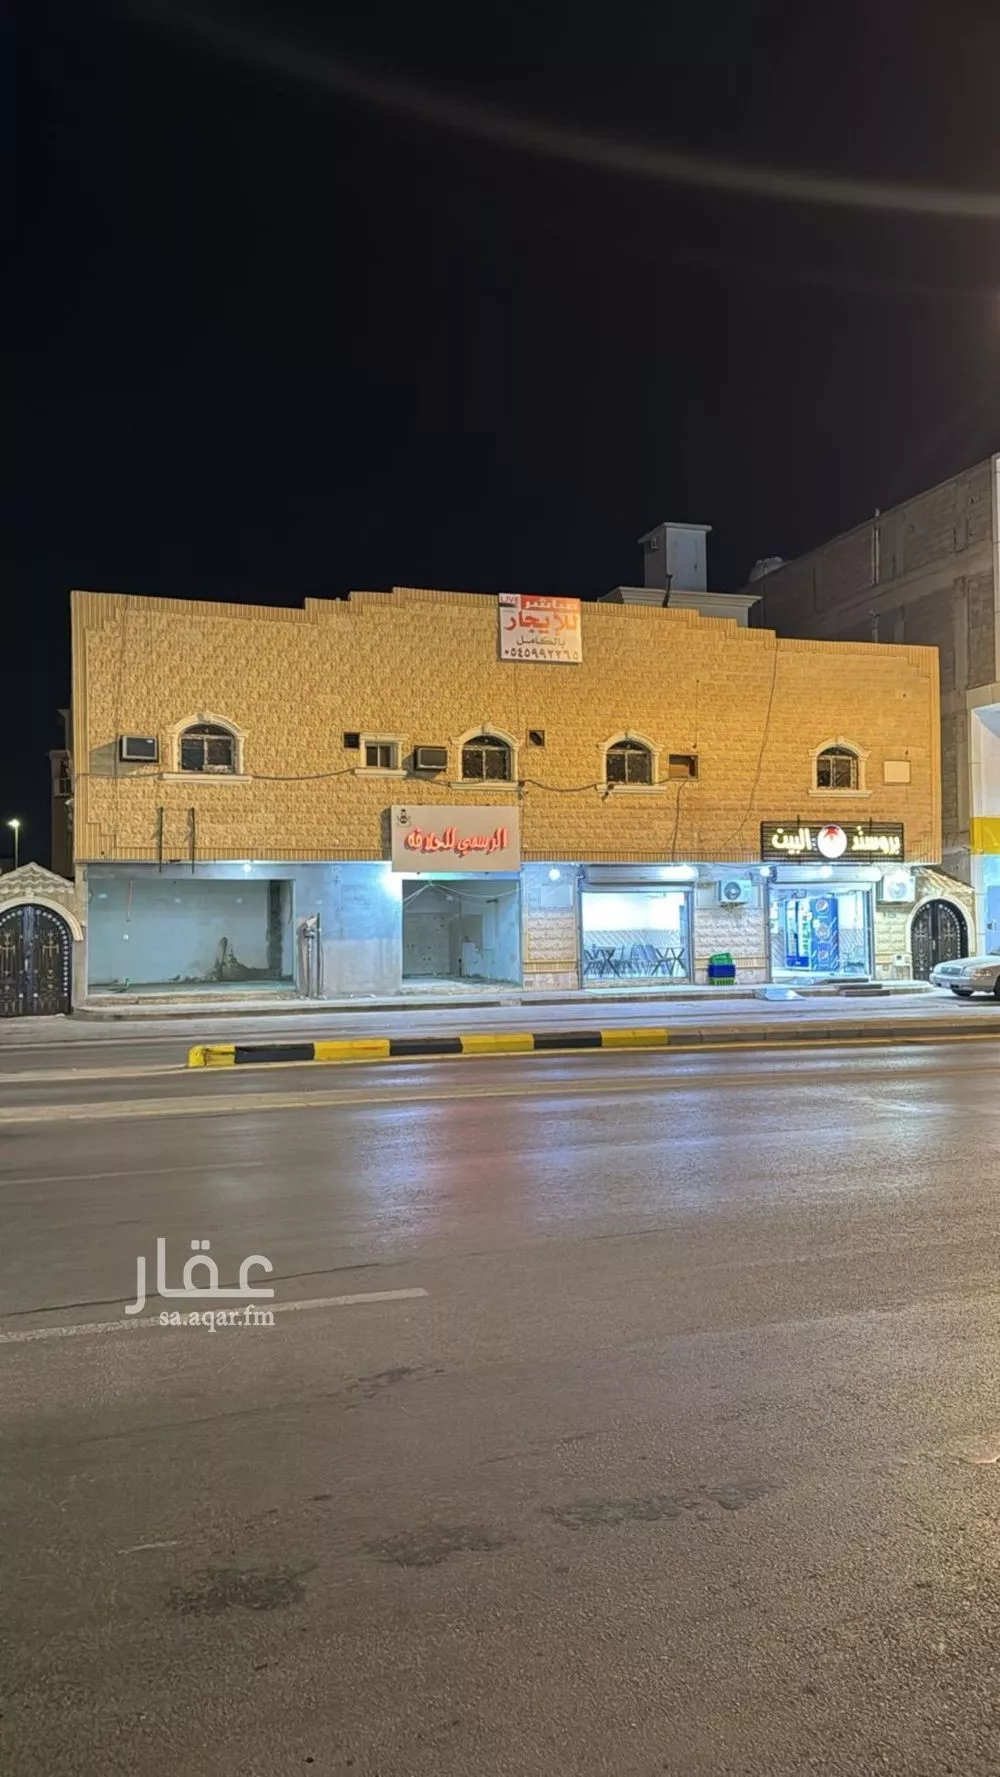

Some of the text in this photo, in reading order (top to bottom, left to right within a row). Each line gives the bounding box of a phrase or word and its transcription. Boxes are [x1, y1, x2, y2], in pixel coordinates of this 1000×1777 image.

[516, 634, 566, 648] بالكامل
[456, 827, 508, 856] الرسمي
[771, 828, 812, 855] البيت
